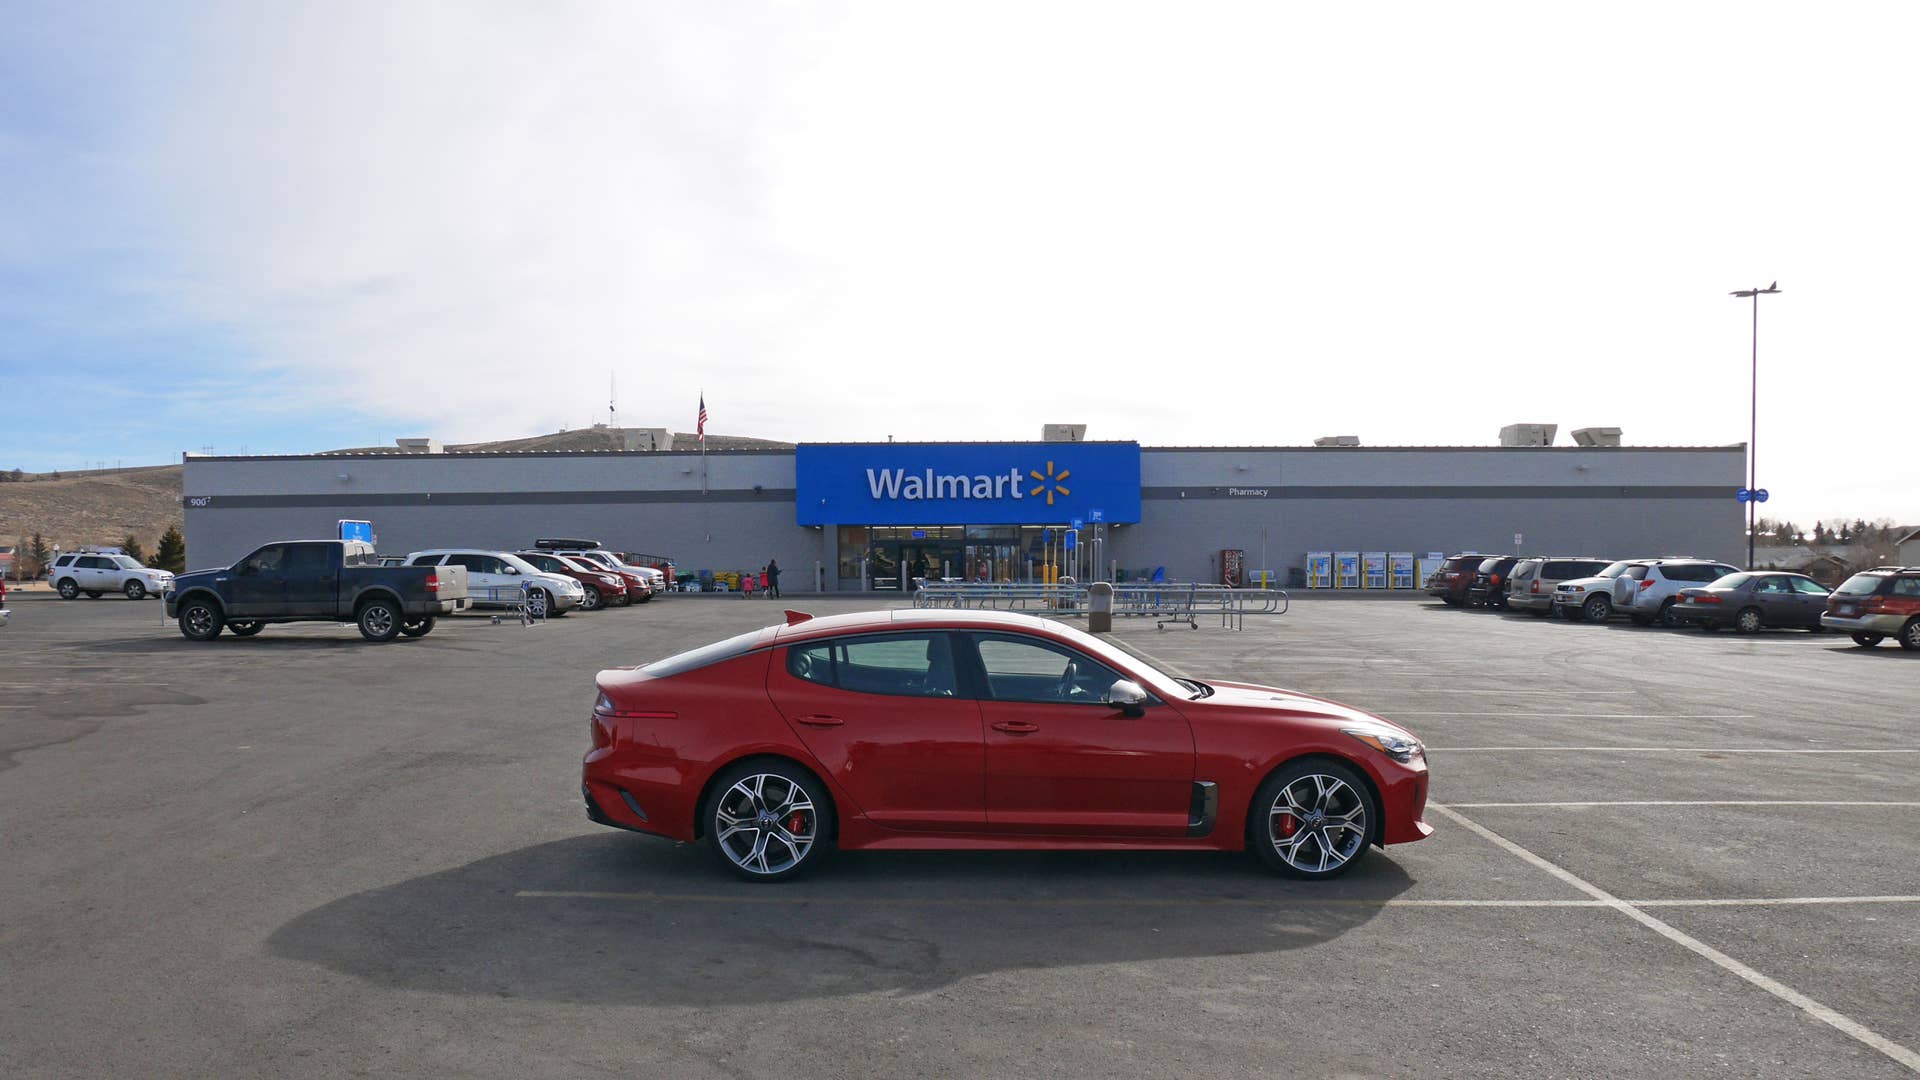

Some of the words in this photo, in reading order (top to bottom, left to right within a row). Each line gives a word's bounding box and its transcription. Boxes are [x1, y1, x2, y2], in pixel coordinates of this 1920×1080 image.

[866, 468, 1023, 499] Walmart
[1229, 487, 1269, 498] Pharmacy
[190, 498, 206, 506] 900
